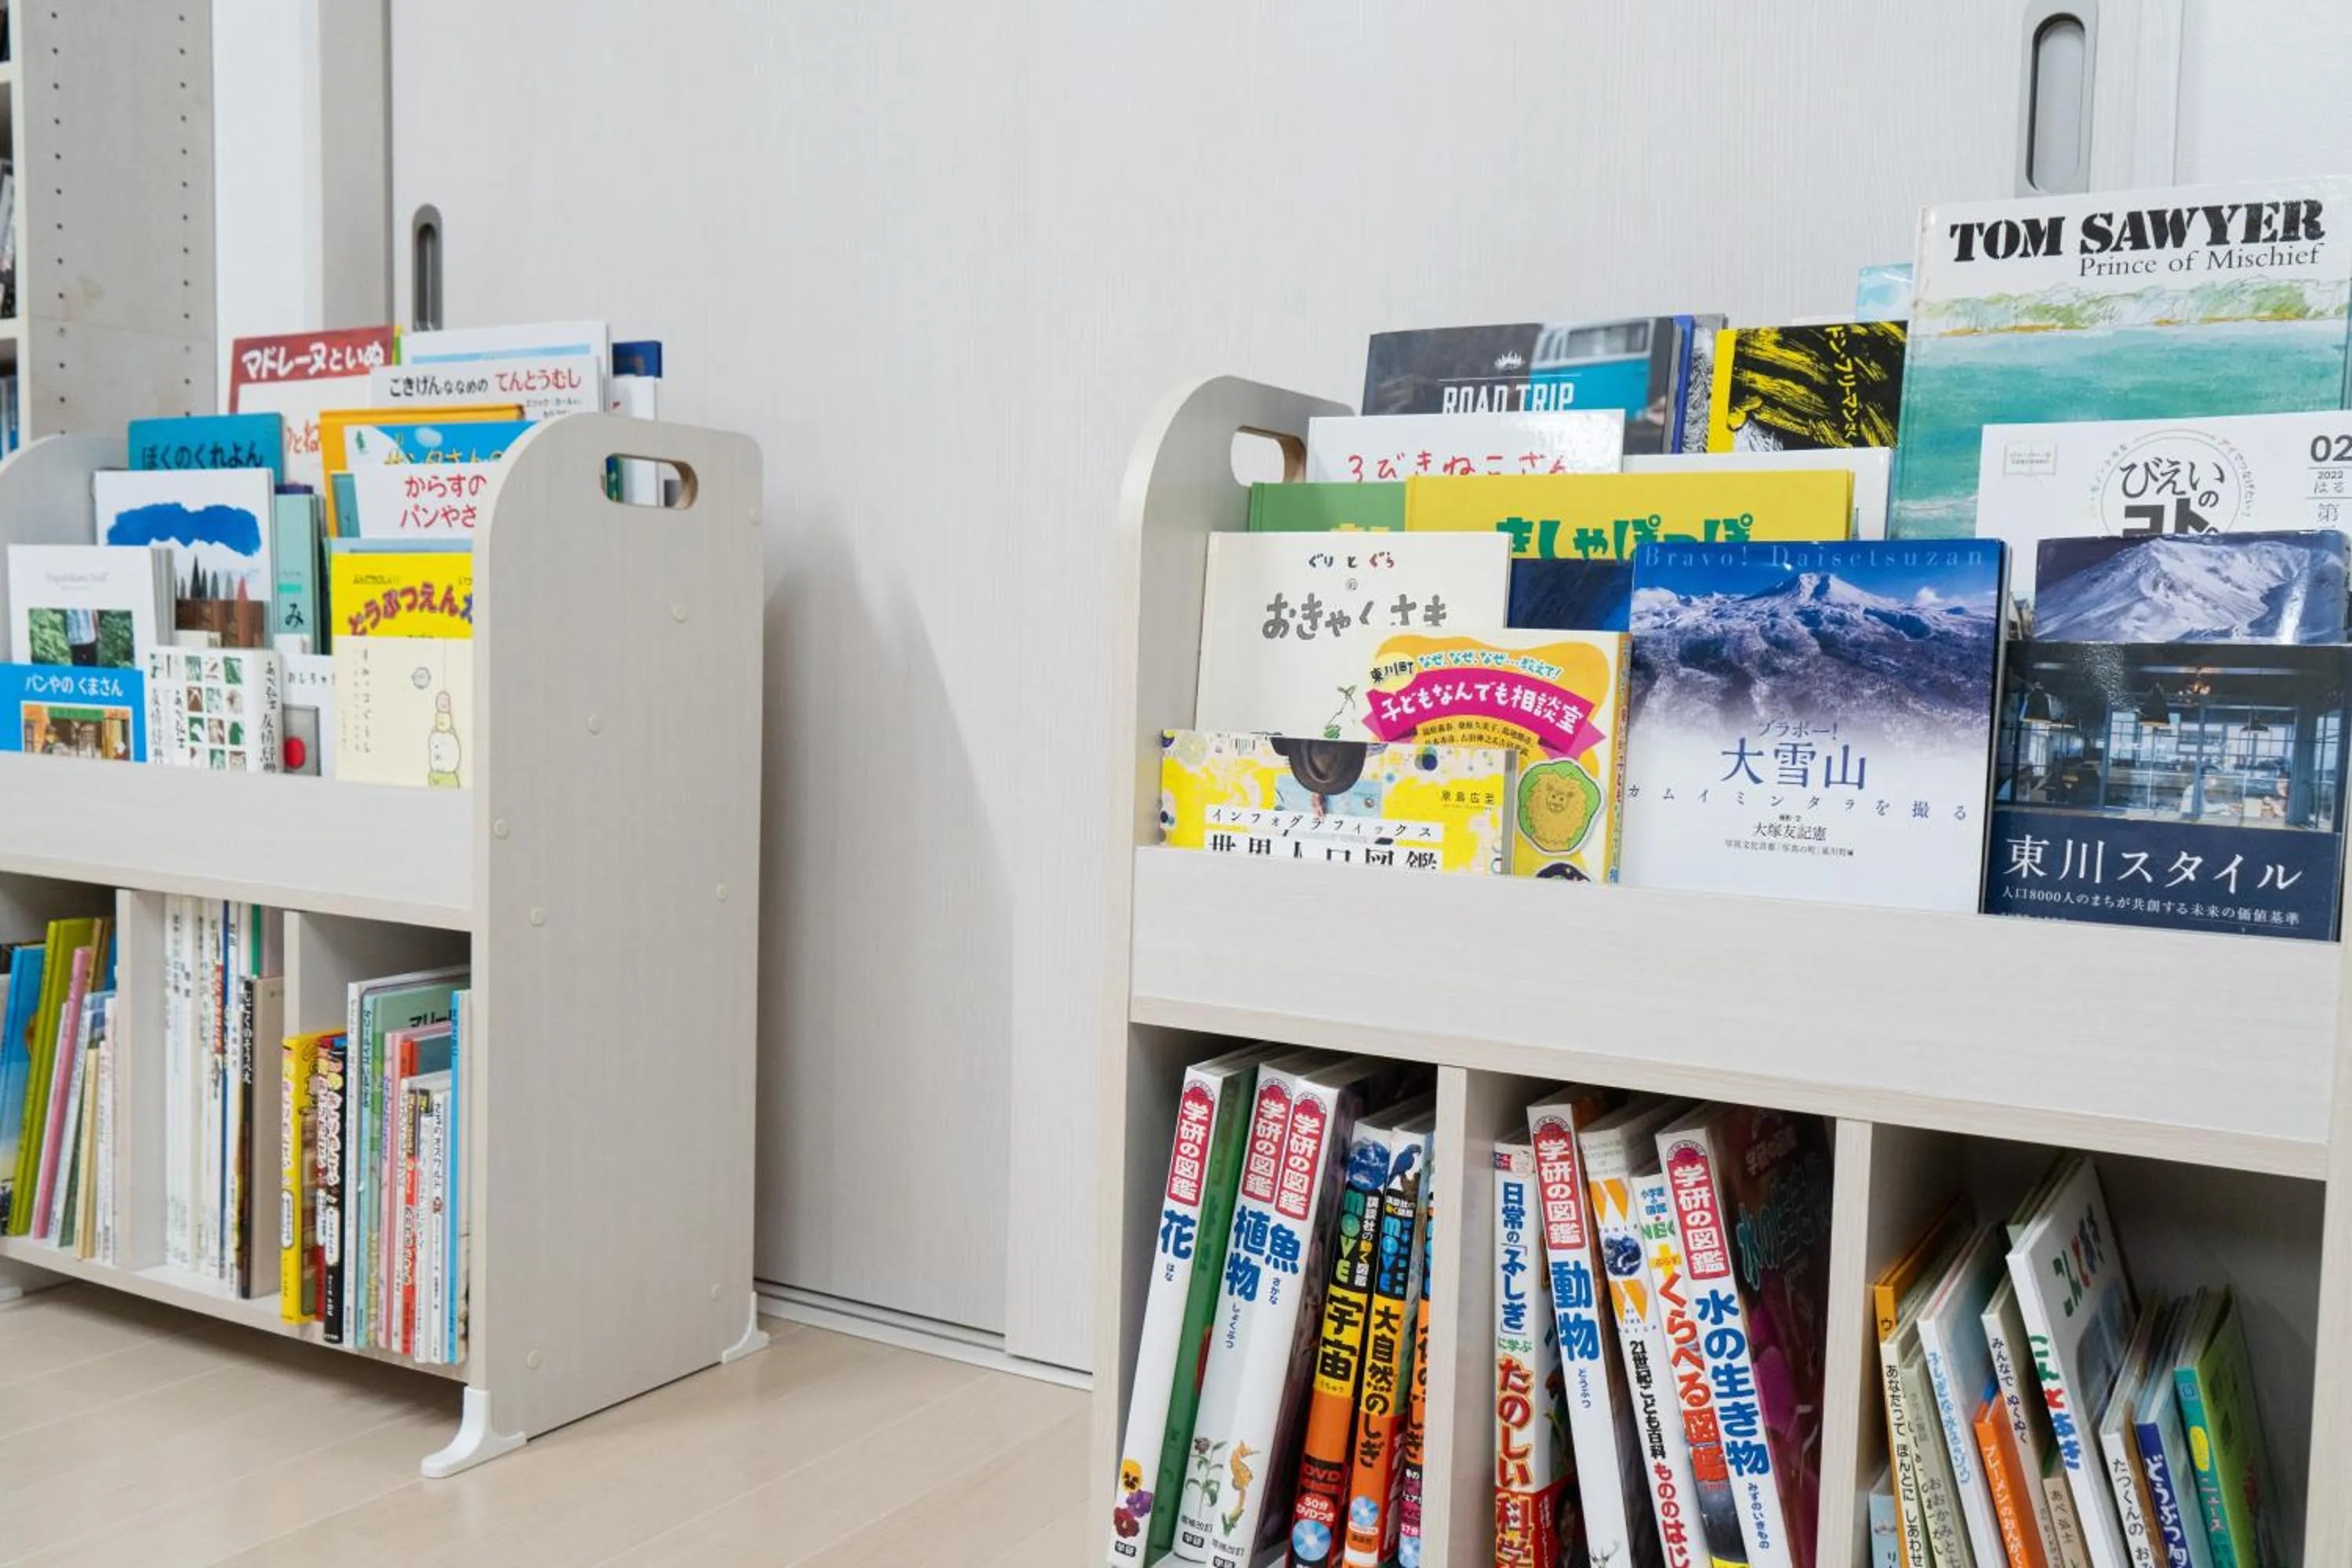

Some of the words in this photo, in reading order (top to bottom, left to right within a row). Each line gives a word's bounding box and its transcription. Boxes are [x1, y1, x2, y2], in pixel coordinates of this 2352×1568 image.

[1950, 216, 2065, 262] TOM
[2079, 198, 2326, 255] SAWYER
[2079, 256, 2158, 277] Prince
[2169, 249, 2199, 273] of
[2206, 241, 2325, 270] Mischief
[241, 341, 384, 379] マドレーヌといぬ
[495, 367, 581, 392] てんとうむし
[1443, 385, 1509, 415] ROAD
[1514, 381, 1575, 412] TRIP
[142, 441, 263, 470] ぼくのくれよん
[2310, 434, 2352, 462] 02
[404, 473, 488, 498] からすの
[2317, 470, 2343, 480] 2022
[1645, 545, 1748, 568] Bravo!
[1771, 544, 1984, 568] Daisetsuzan
[285, 602, 304, 627] み
[25, 673, 74, 693] パンやの
[78, 675, 124, 697] くまさん
[1370, 662, 1414, 684] 東川町
[1381, 681, 1586, 735] 子どもなんでも相談室
[1721, 737, 1866, 791] 大雪山
[1212, 809, 1432, 838] インフォグラフィックス
[2002, 834, 2303, 895] 東川スタイル
[1171, 1099, 1209, 1202] 学研の図鑑
[1246, 1098, 1287, 1198] 学研の図鑑
[1278, 1113, 1320, 1215] 学研の図鑑
[1538, 1138, 1581, 1245] 学研の図鑑
[1160, 1208, 1196, 1260] 花
[1674, 1163, 1725, 1275] 学研の図鑑
[1225, 1205, 1271, 1303] 植物
[1265, 1223, 1301, 1275] 魚
[1550, 1260, 1600, 1362] 動物
[1319, 1294, 1367, 1382] 宇宙
[1694, 1289, 1771, 1477] 水の生き物
[1992, 1338, 2013, 1387] みんなで
[2007, 1395, 2027, 1444] ぬくぬく
